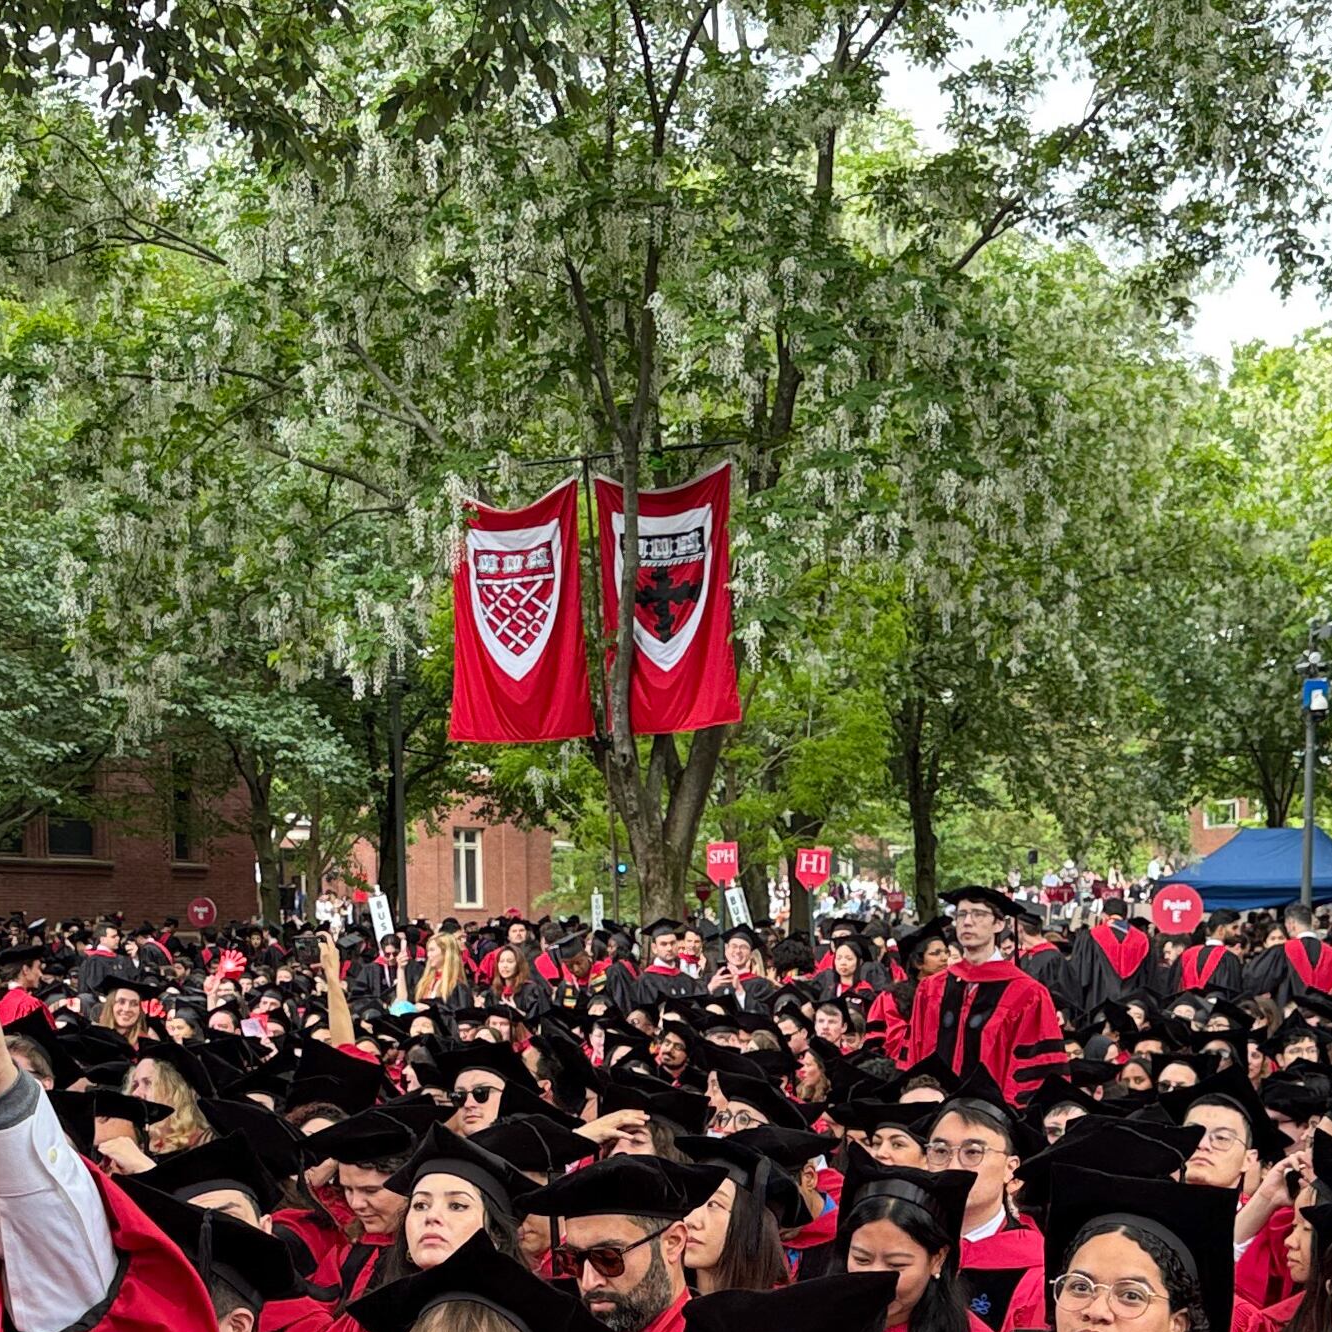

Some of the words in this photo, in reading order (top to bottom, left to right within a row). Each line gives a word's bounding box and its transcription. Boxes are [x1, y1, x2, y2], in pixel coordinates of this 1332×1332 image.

[709, 848, 736, 864] SPH
[1162, 899, 1193, 911] Point
[375, 900, 388, 932] BUS
[1172, 910, 1182, 924] E
